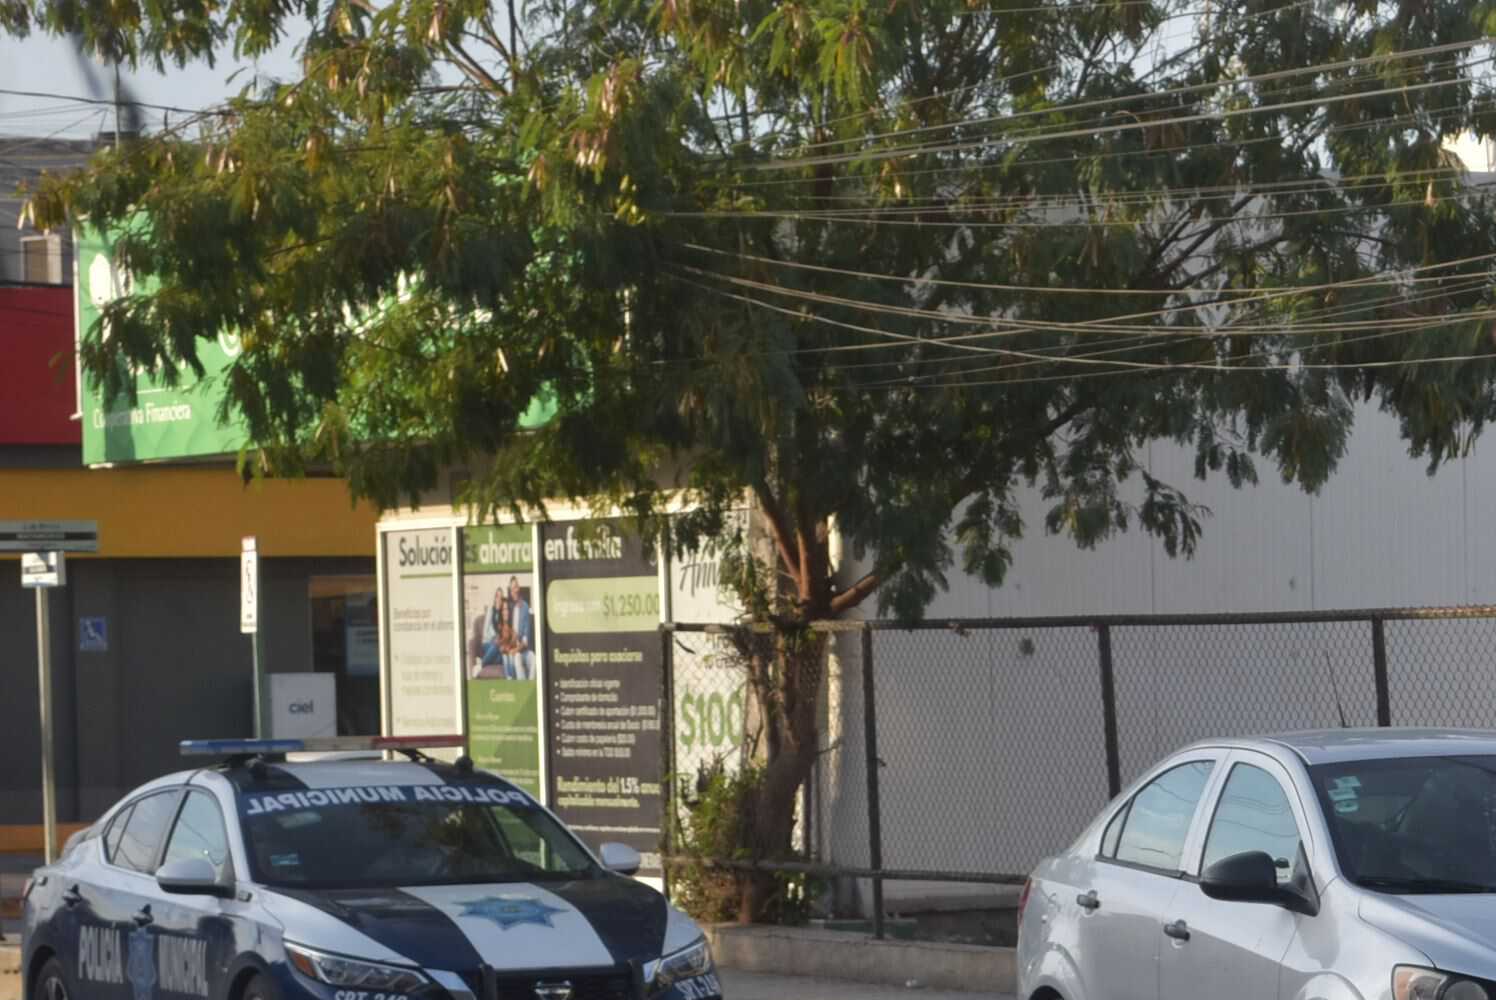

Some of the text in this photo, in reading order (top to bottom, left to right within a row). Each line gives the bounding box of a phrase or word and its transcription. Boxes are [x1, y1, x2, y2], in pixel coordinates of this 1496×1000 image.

[544, 538, 565, 561] en
[289, 701, 314, 714] ciel
[159, 935, 208, 997] MUNICIPAL
